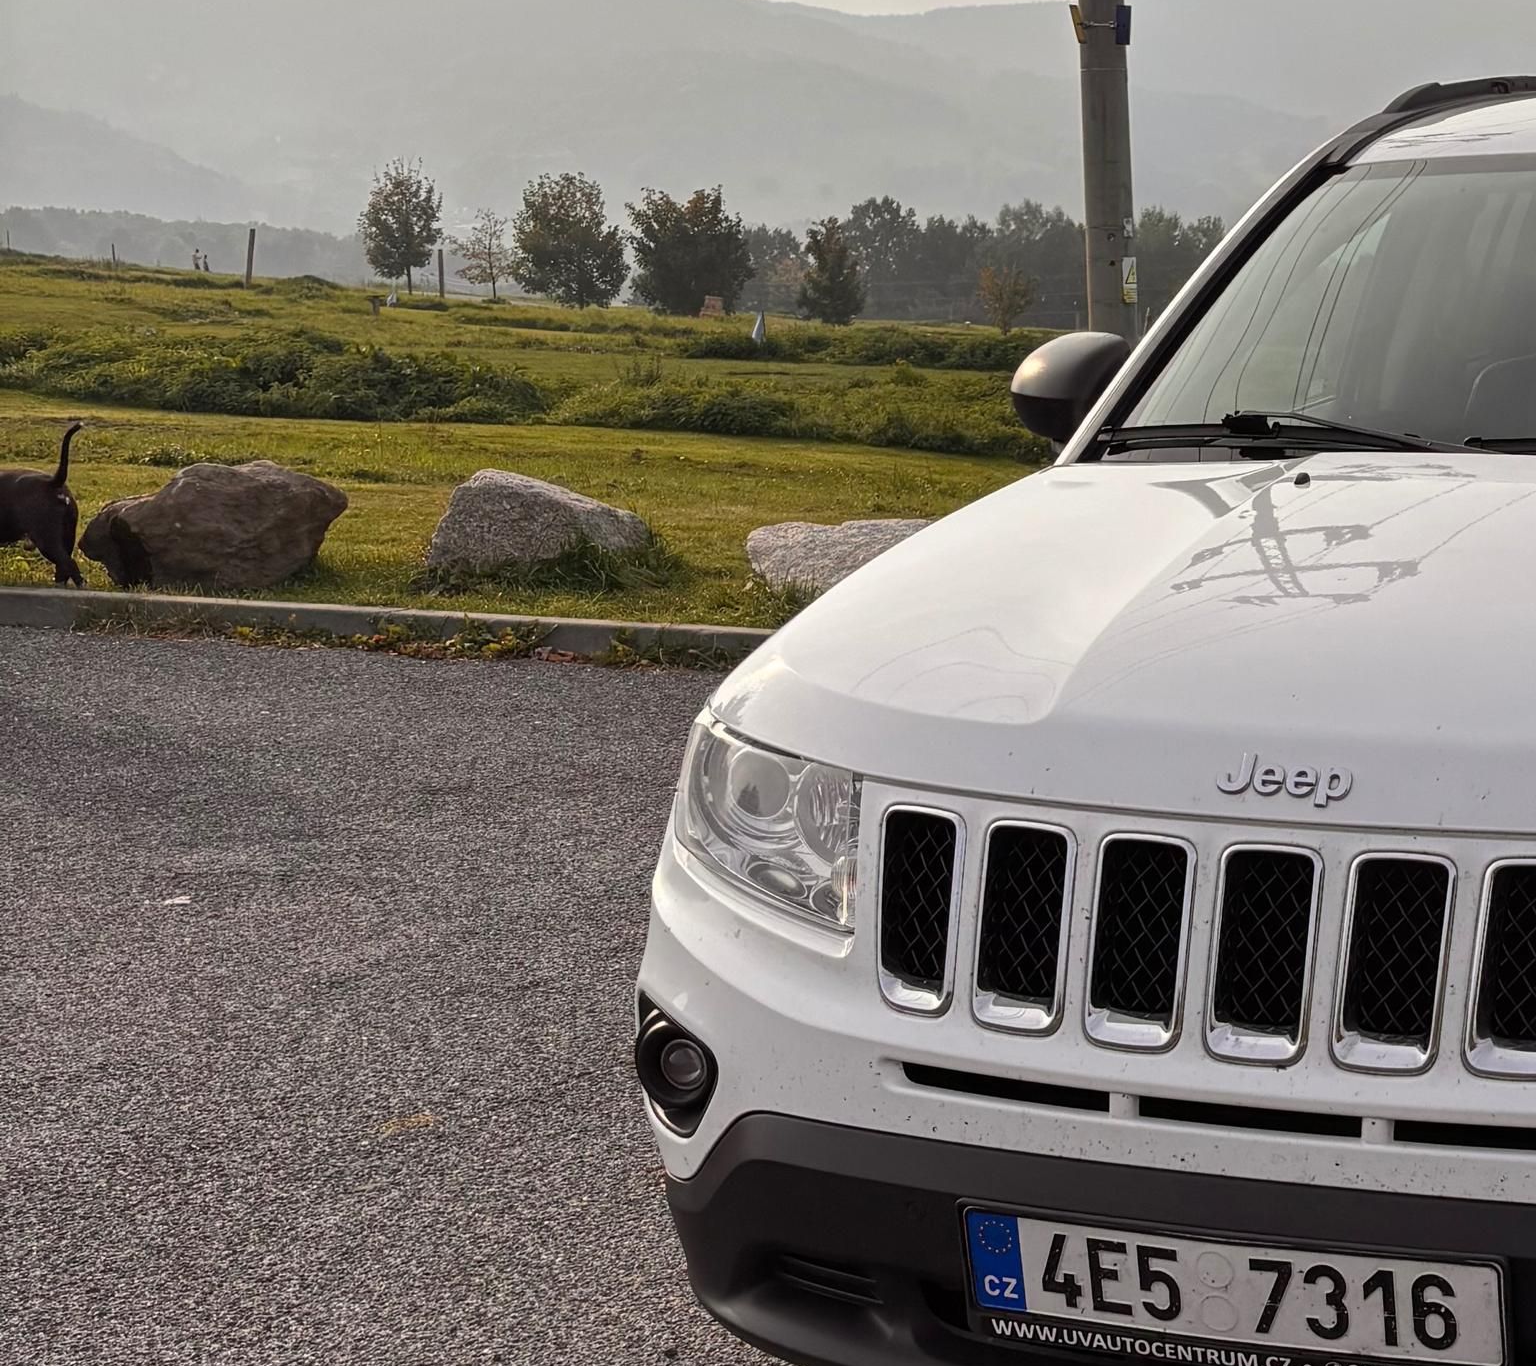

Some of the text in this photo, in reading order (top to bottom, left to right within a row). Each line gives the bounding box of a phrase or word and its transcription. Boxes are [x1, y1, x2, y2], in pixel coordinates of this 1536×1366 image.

[1216, 752, 1353, 808] Jeep
[984, 1274, 1018, 1299] CZ
[1042, 1233, 1458, 1350] 4E5 7316
